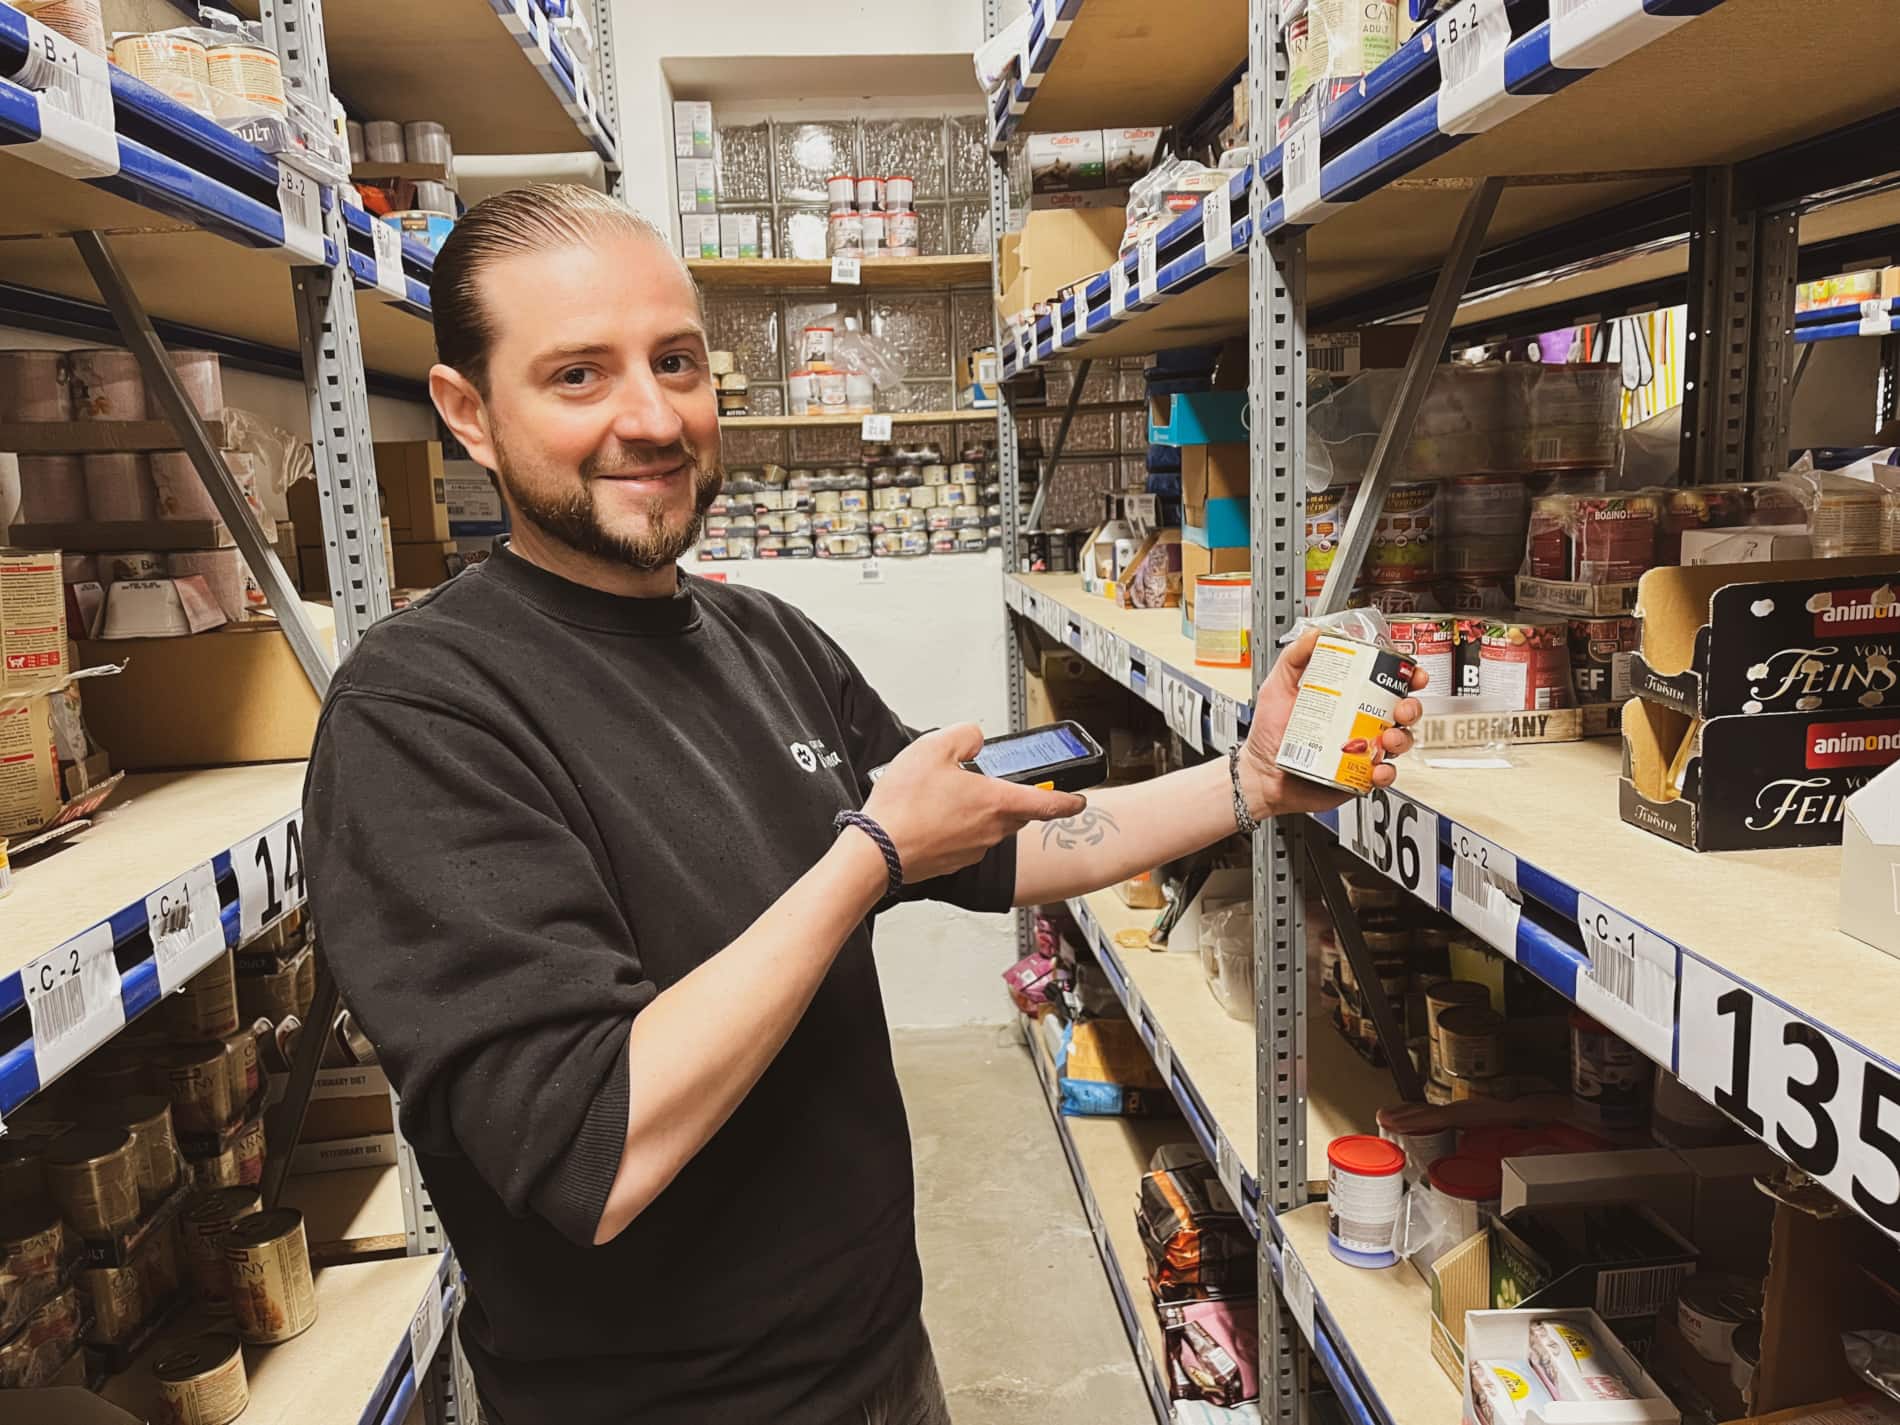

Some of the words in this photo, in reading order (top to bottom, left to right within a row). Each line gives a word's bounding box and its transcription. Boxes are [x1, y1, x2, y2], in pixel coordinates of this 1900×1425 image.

[1362, 24, 1390, 33] ADULT
[1050, 136, 1080, 145] Calibra
[1123, 130, 1155, 139] Calibra
[1855, 645, 1892, 657] VOM
[1358, 702, 1388, 718] ADULT
[1352, 787, 1420, 890] 136
[1714, 987, 1900, 1234] 135
